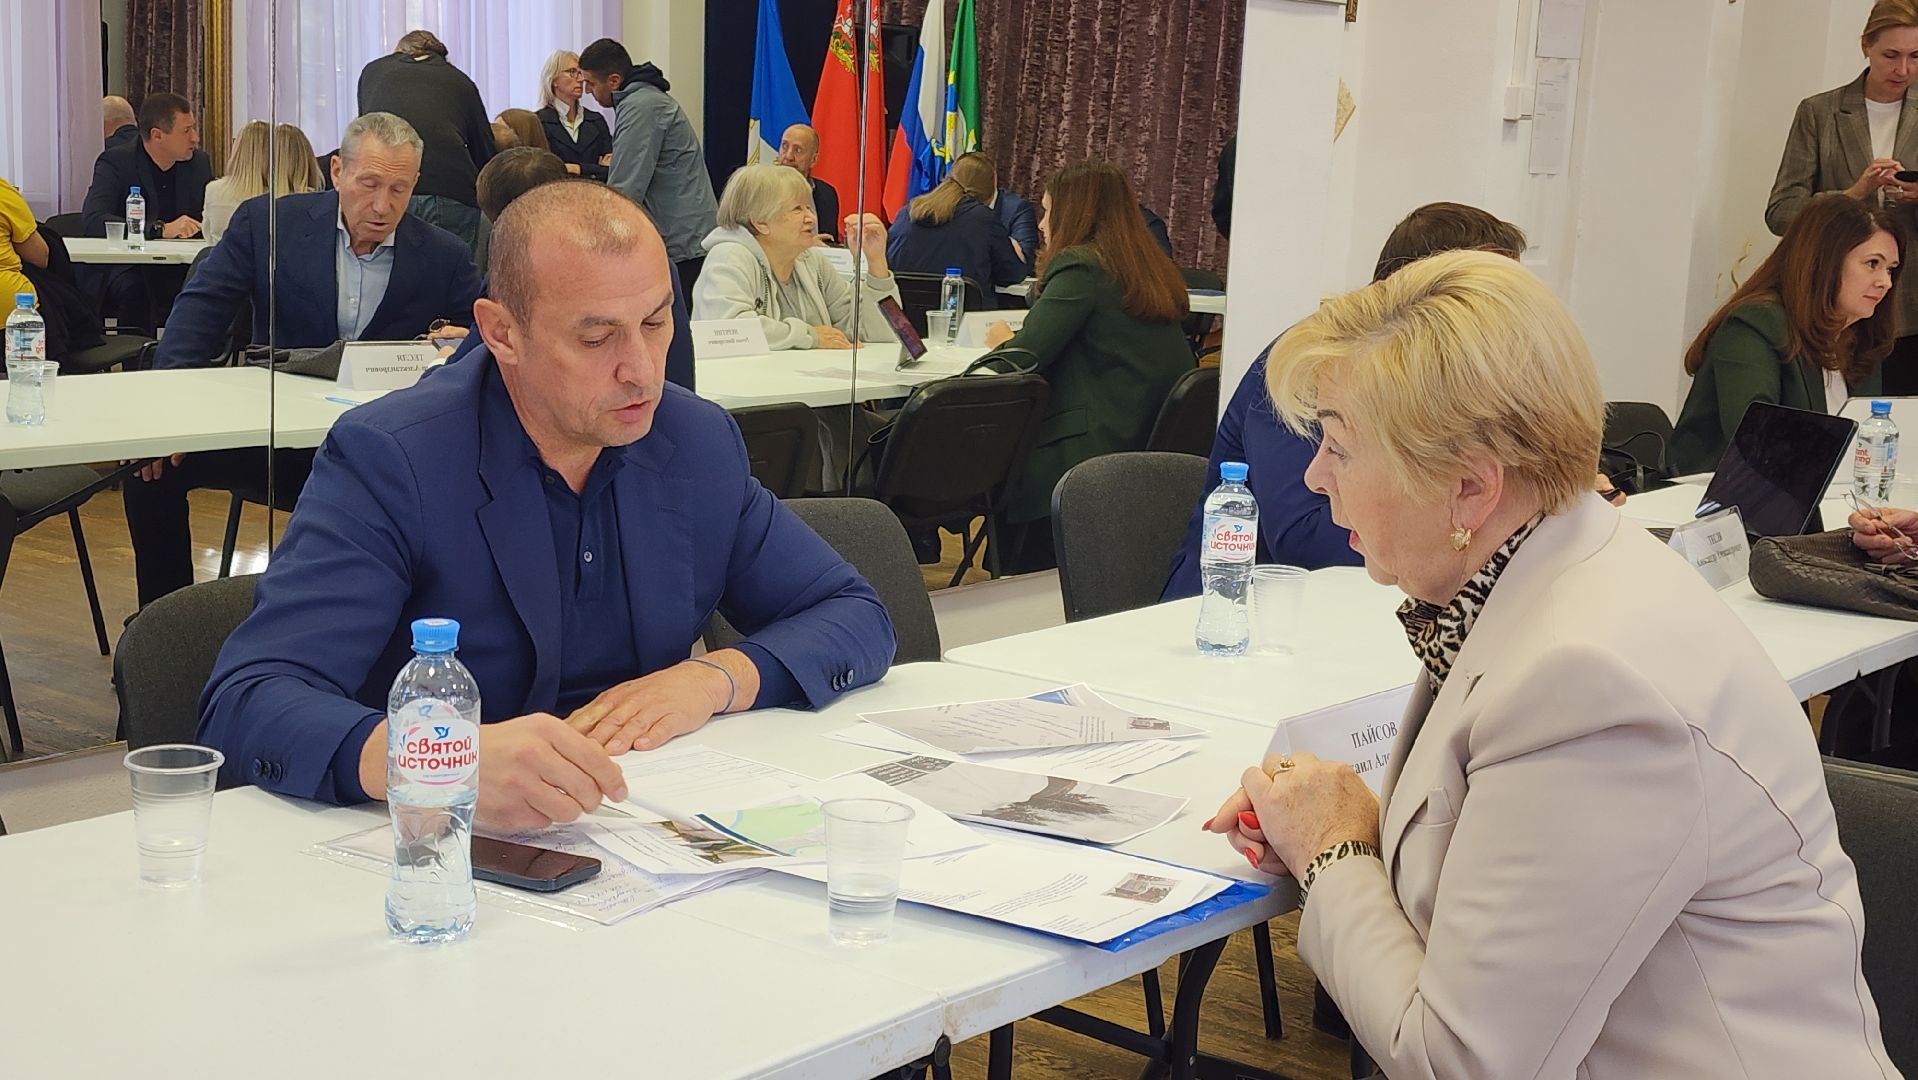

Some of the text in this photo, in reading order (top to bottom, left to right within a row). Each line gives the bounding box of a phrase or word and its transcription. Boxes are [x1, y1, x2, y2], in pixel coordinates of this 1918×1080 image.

[1210, 541, 1255, 551] ИСТОЧНИ
[406, 735, 472, 755] СВЯТОЙ
[1351, 721, 1398, 749] ПАЙСОВ
[398, 750, 478, 770] ИСТОЧНИК
